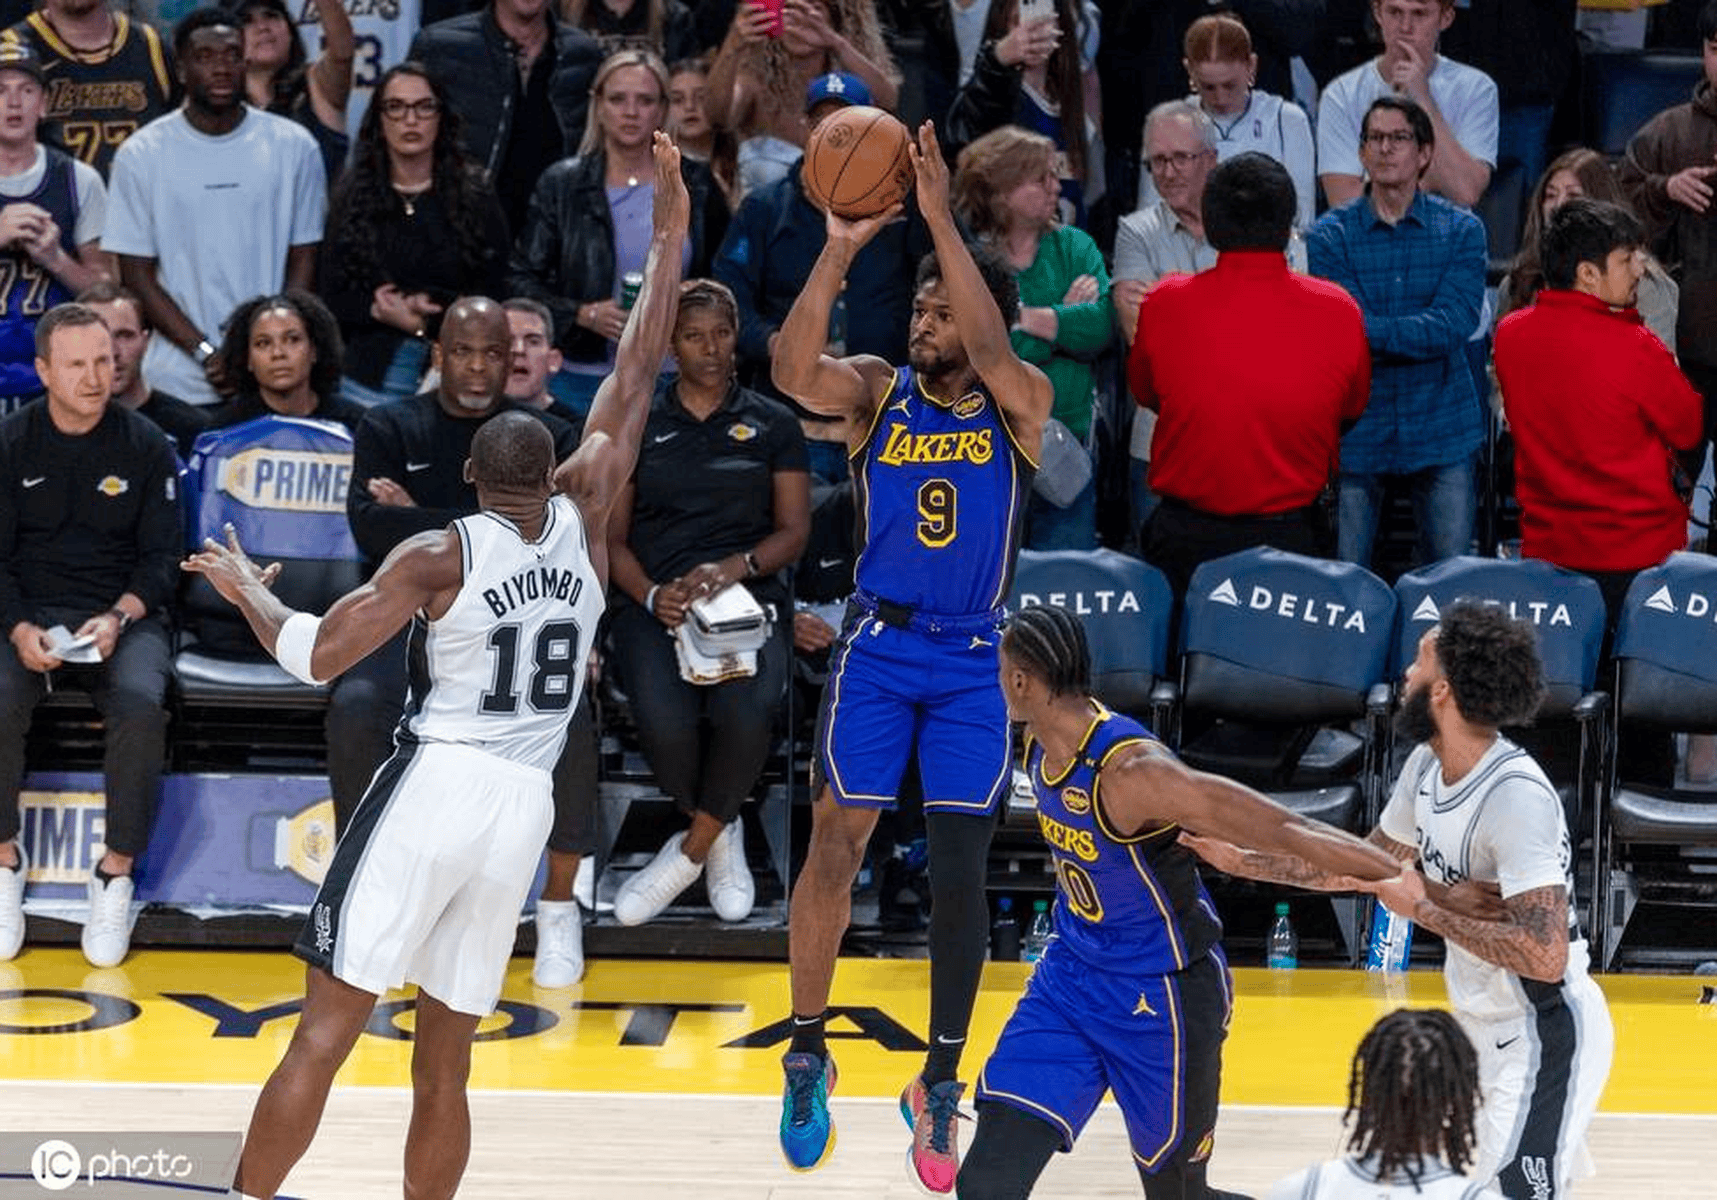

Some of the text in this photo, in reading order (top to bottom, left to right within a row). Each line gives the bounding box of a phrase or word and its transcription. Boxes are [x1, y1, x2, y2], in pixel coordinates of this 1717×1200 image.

[877, 423, 993, 466] LAKERS
[254, 459, 351, 503] PRIME
[917, 479, 957, 548] 9
[482, 567, 583, 619] BIYOMBO
[1020, 590, 1140, 615] DELTA
[1249, 585, 1366, 634] DELTA
[477, 618, 582, 716] 18
[1038, 812, 1099, 861] KERS
